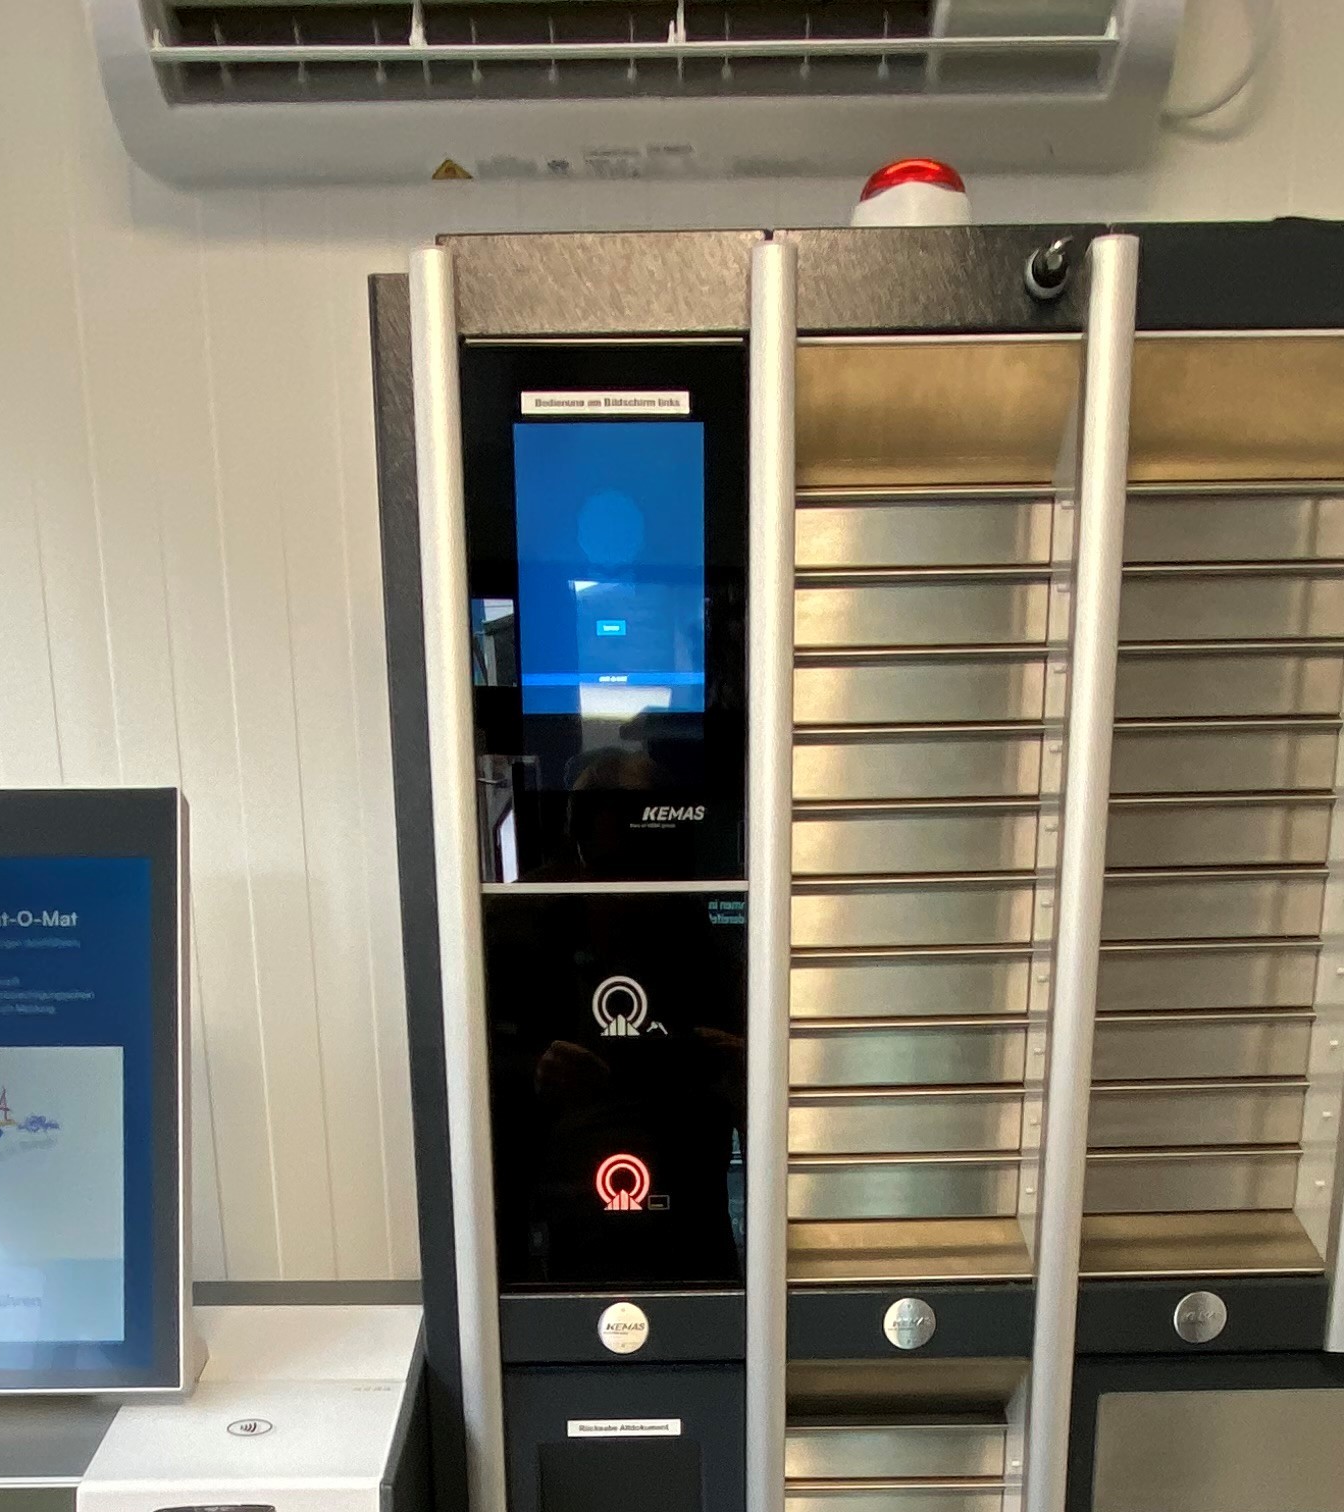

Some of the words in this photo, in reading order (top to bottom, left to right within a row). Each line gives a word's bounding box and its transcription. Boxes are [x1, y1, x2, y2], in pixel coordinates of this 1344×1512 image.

[604, 397, 656, 407] Bildschirm
[658, 397, 680, 407] links
[642, 805, 705, 821] KEMAS
[605, 1322, 645, 1332] KEMAS
